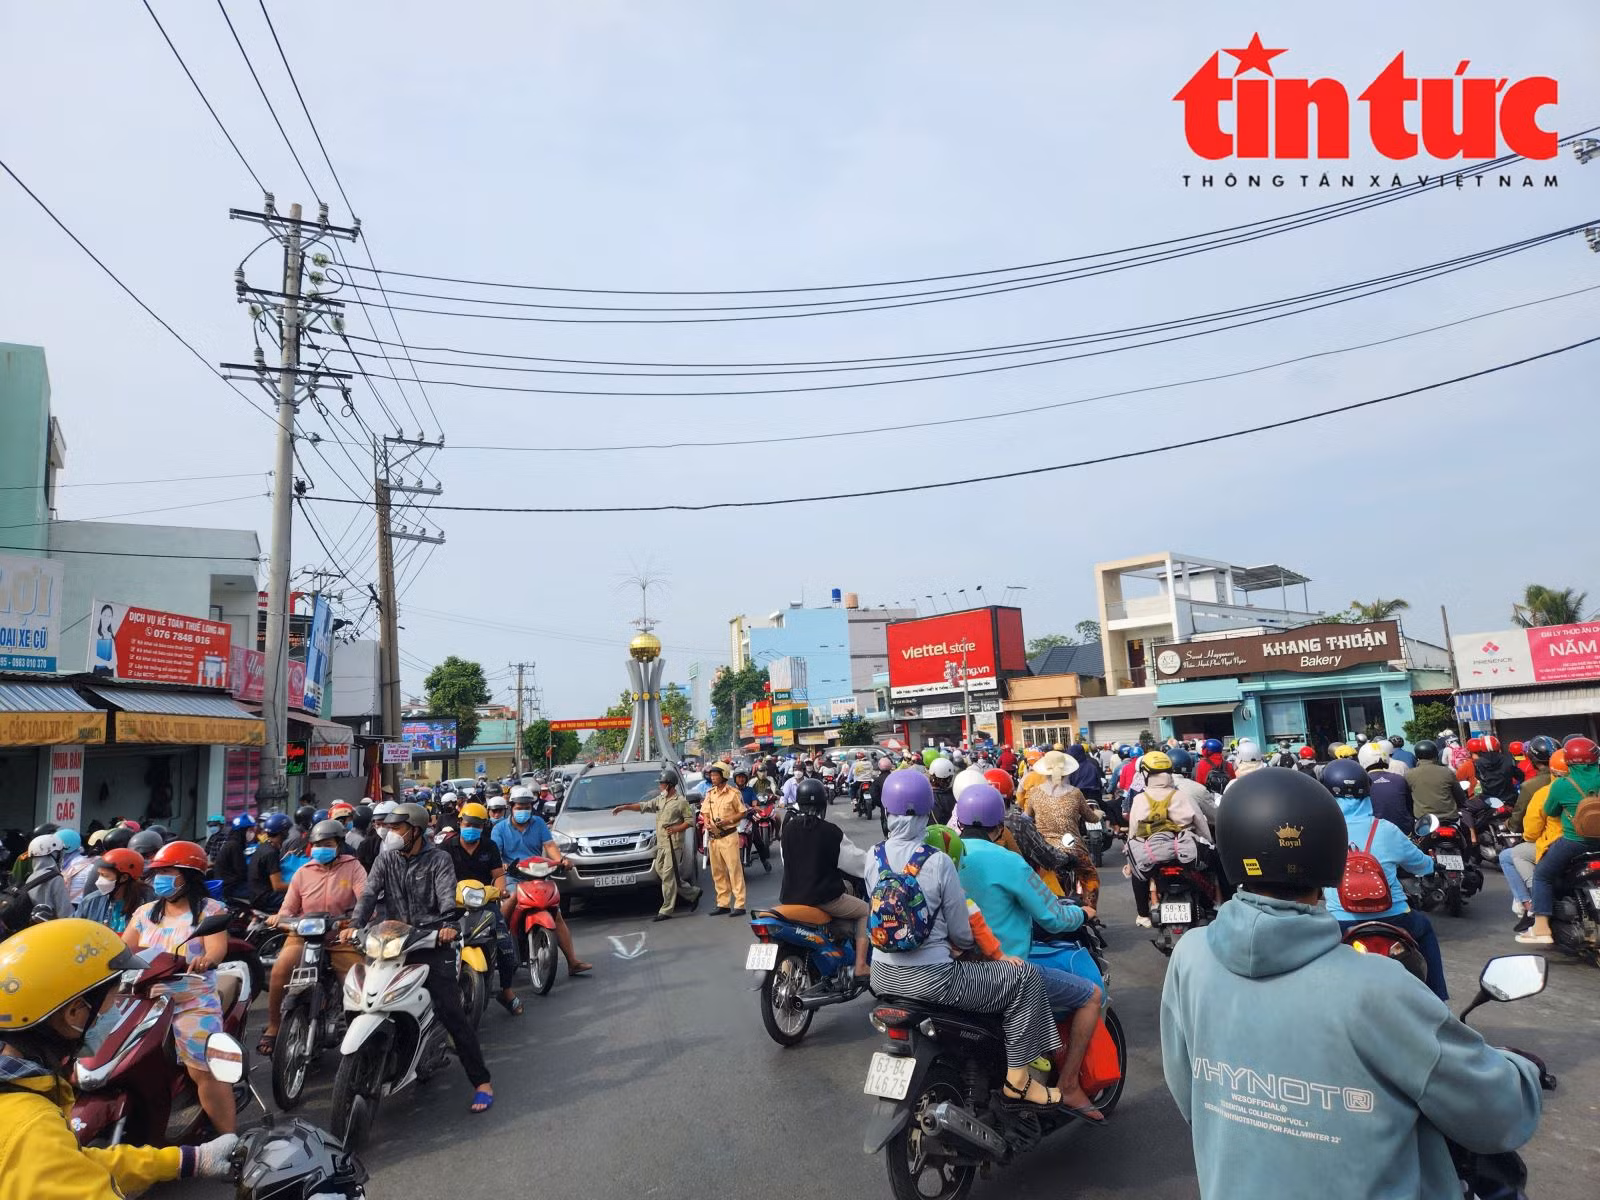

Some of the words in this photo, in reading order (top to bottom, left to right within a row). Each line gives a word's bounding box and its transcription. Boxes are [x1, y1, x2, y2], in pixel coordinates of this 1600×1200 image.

[18, 629, 31, 648] XE
[153, 629, 171, 639] 076
[172, 632, 193, 642] 7848
[194, 636, 211, 645] 016
[1262, 637, 1321, 657] KHANG
[1326, 627, 1388, 651] THUẬN
[902, 642, 948, 660] viettel
[949, 642, 976, 654] store
[1549, 639, 1598, 657] NĂM
[1300, 654, 1342, 667] Bakery
[53, 752, 68, 769] MUA
[53, 777, 66, 794] THU
[67, 777, 80, 794] MUA
[56, 799, 75, 820] CÁC
[600, 837, 629, 847] ISUZU
[1279, 839, 1301, 848] Royal
